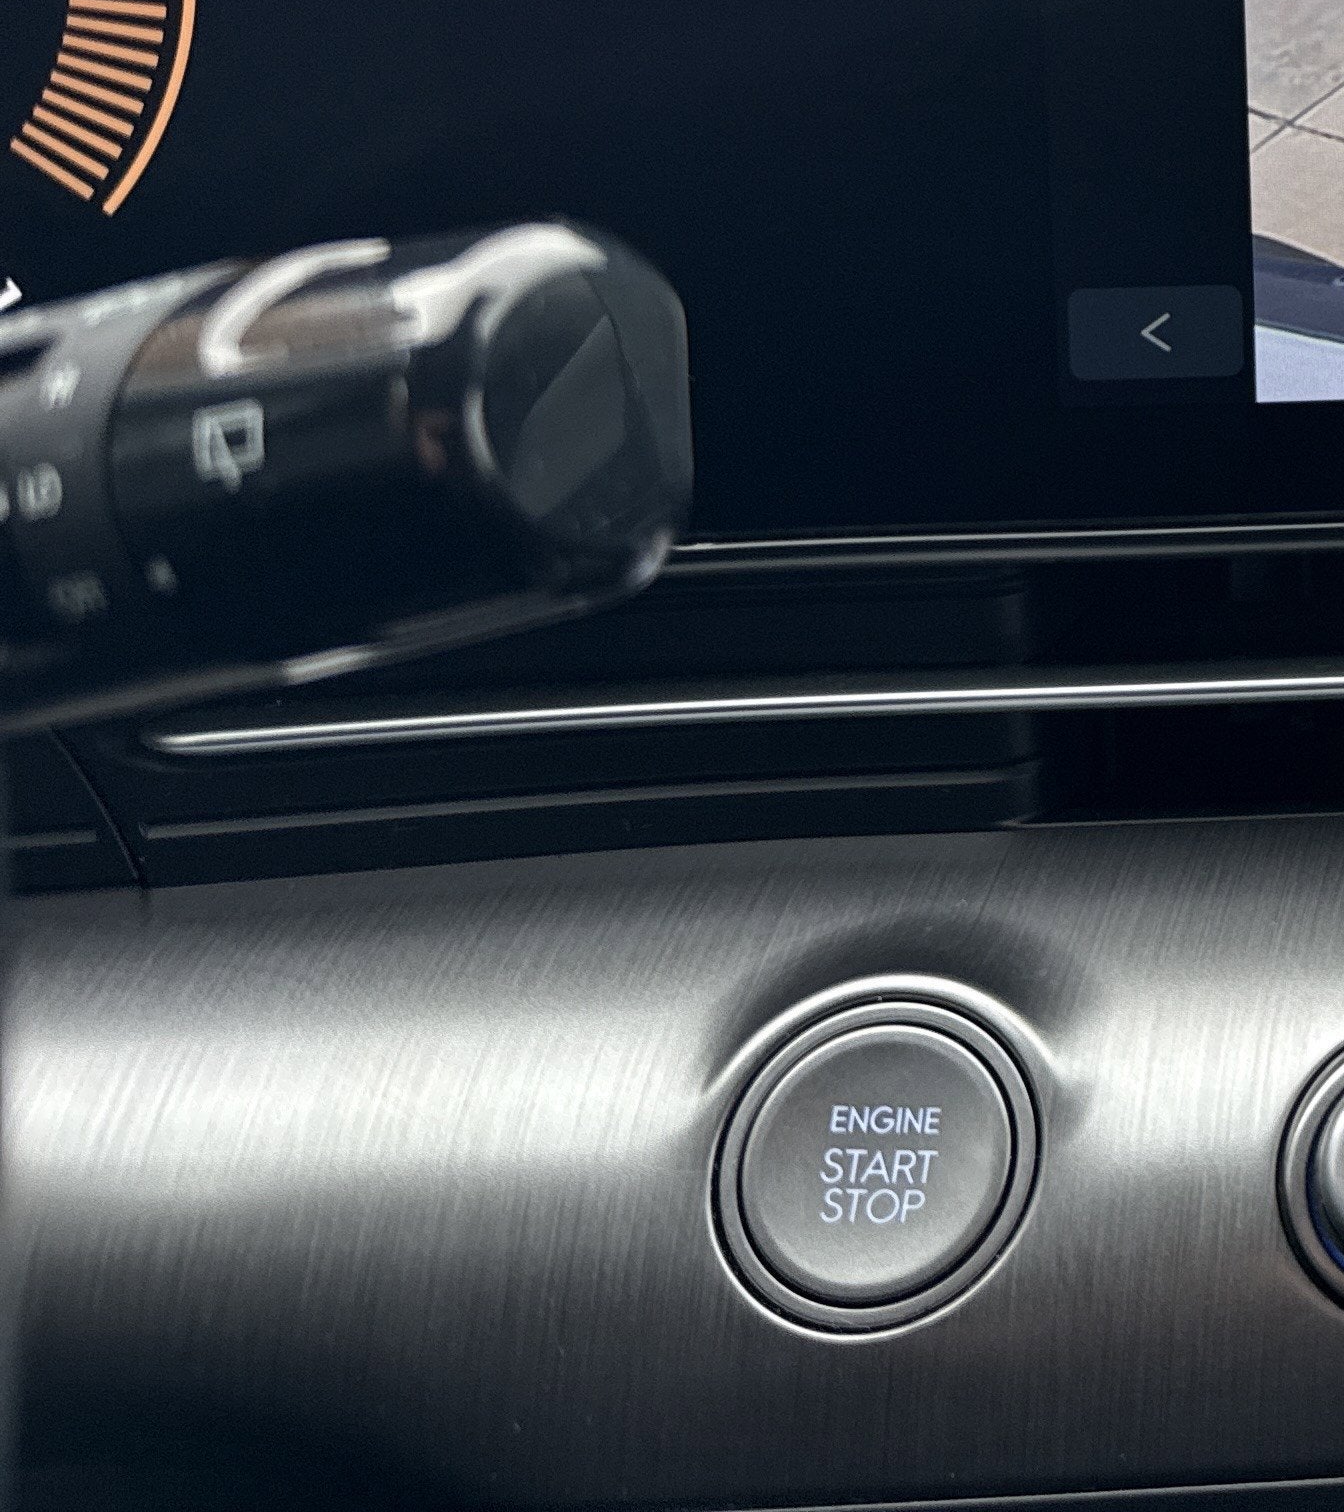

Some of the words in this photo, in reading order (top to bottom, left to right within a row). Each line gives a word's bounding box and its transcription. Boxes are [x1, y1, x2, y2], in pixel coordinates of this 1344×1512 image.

[830, 1104, 943, 1136] ENGINE
[819, 1147, 939, 1185] START
[819, 1187, 926, 1225] STOP
